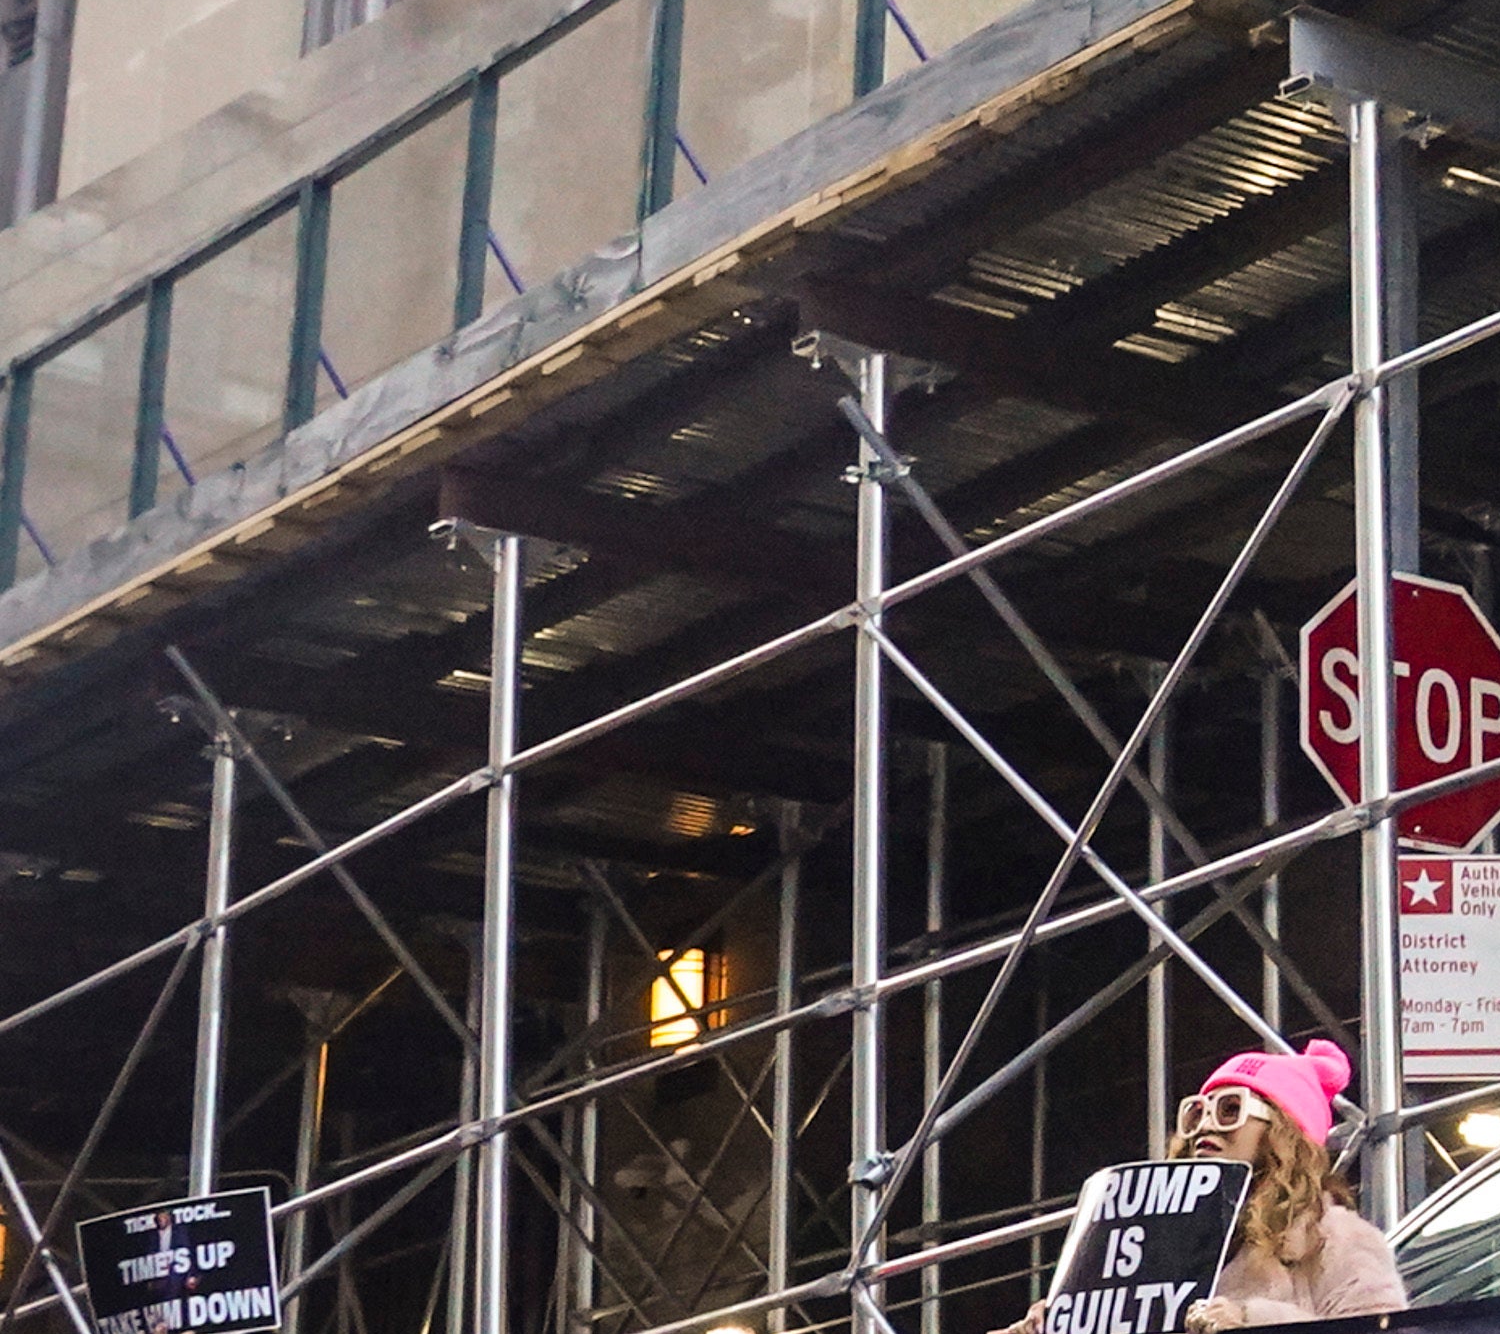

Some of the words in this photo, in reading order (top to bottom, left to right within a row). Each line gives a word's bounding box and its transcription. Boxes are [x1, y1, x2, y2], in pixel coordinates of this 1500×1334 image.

[1460, 900, 1497, 918] Only
[1401, 933, 1467, 949] District
[1402, 957, 1479, 975] Attorney
[1400, 997, 1461, 1016] Monday
[1402, 1017, 1435, 1034] 7am
[1451, 1017, 1485, 1035] 7pm
[1090, 1164, 1222, 1223] RUMP
[123, 1213, 157, 1235] TICK
[1102, 1224, 1146, 1280] IS
[117, 1246, 191, 1286] TIME'S
[196, 1240, 236, 1271] UP
[187, 1285, 272, 1327] DOWN
